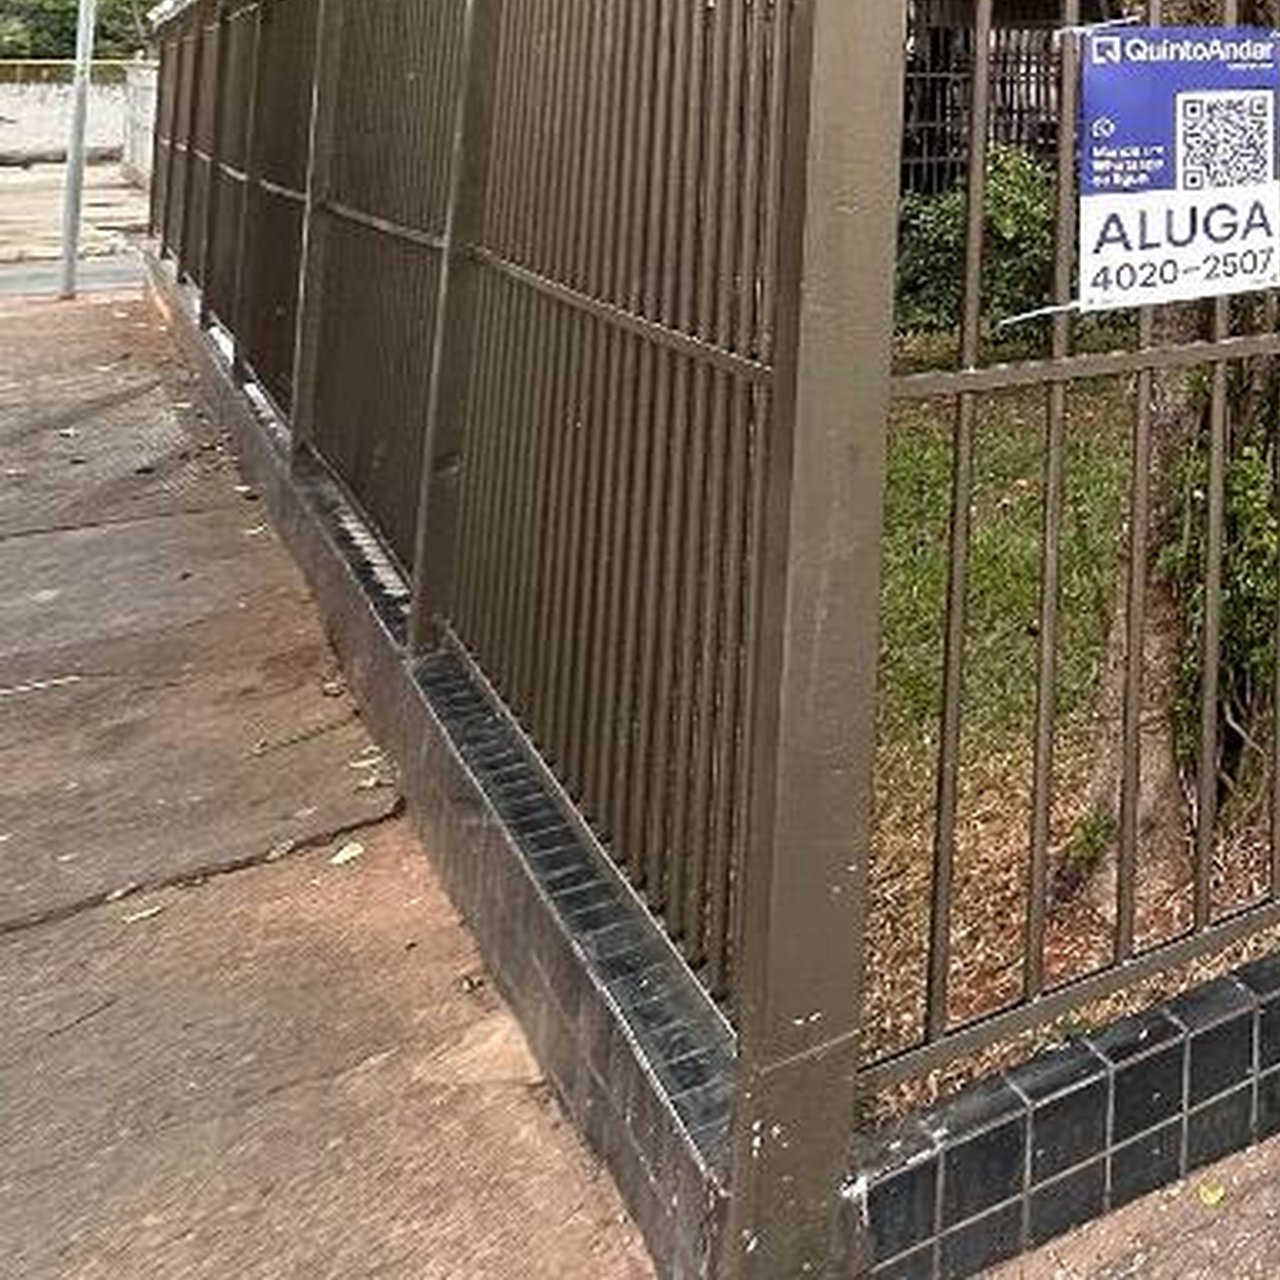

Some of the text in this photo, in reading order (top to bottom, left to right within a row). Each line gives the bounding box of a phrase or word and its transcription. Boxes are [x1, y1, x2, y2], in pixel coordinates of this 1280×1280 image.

[1124, 37, 1275, 62] QuintoAndar
[1093, 200, 1273, 254] ALUGA
[1090, 247, 1275, 291] 4020-2507
